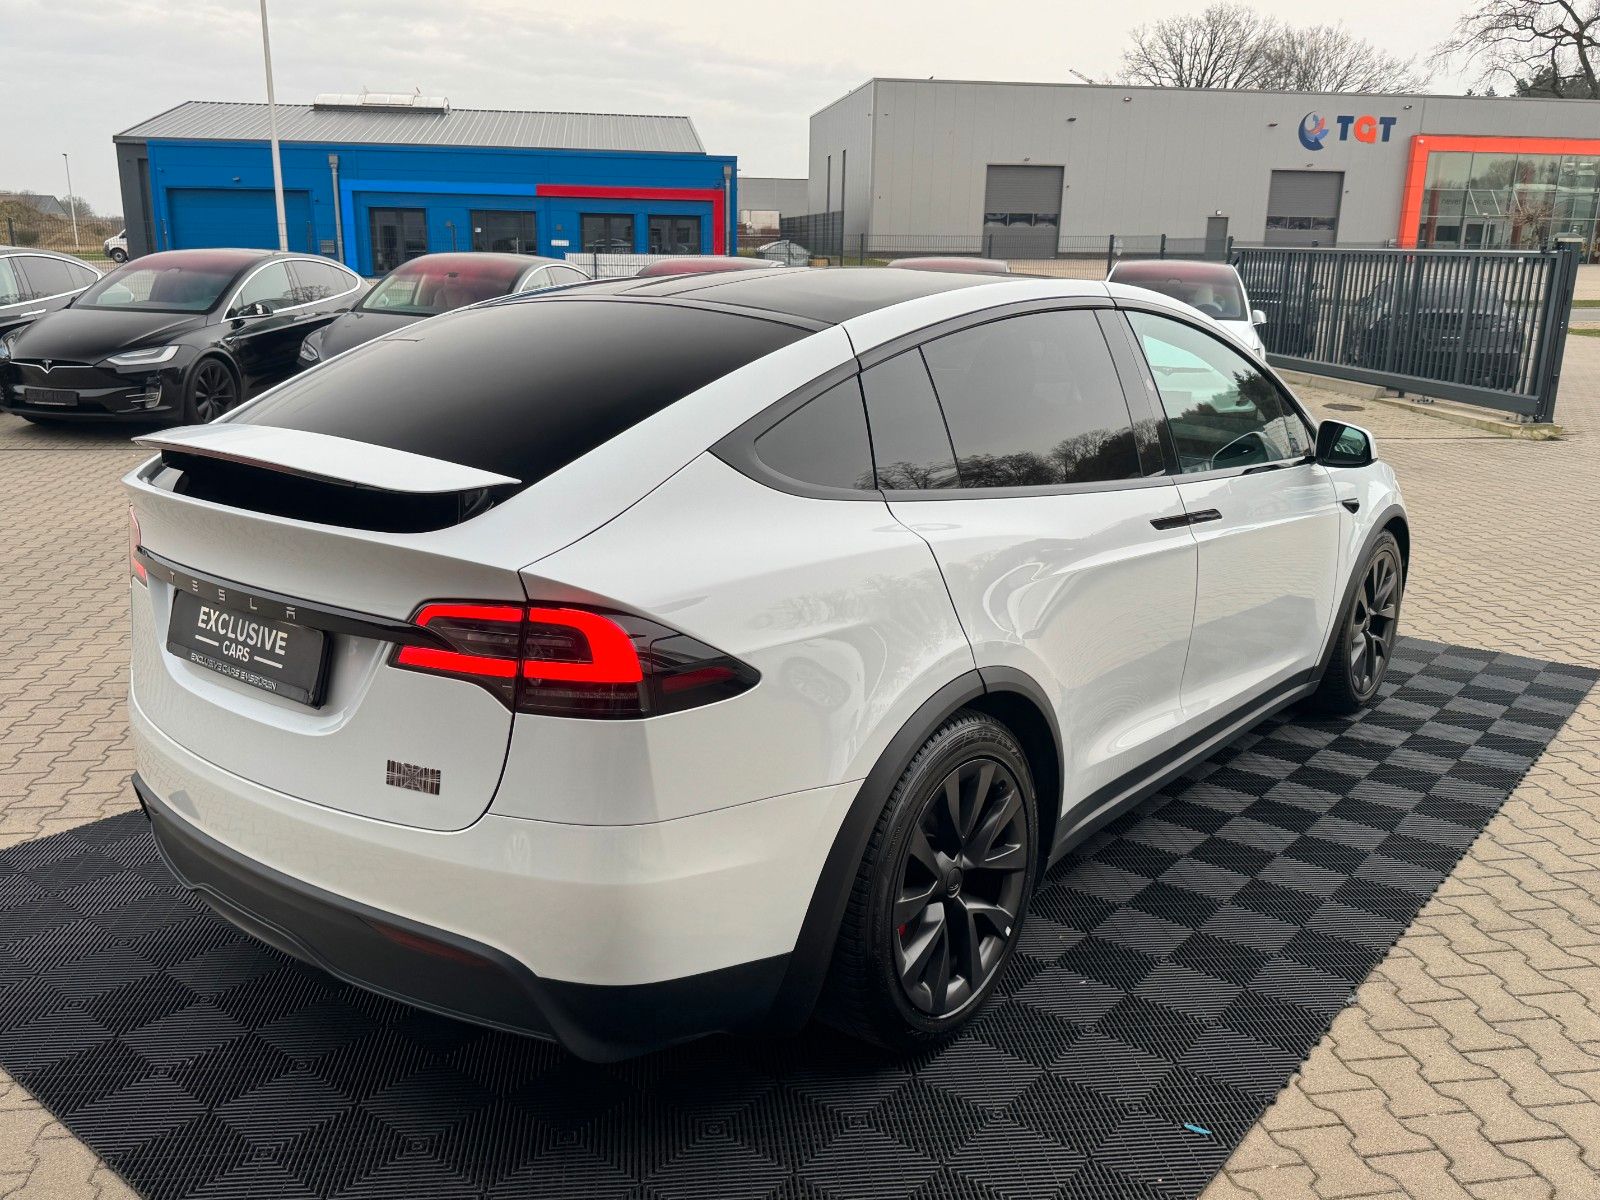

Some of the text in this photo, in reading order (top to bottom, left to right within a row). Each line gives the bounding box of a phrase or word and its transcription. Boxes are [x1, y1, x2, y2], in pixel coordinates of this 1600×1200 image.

[1336, 114, 1397, 144] TGT
[169, 571, 296, 620] TESLA
[198, 605, 288, 656] EXCLUSIVE
[190, 652, 222, 671] EXCLUSIVE
[222, 664, 240, 678] CARS
[222, 640, 250, 662] CARS
